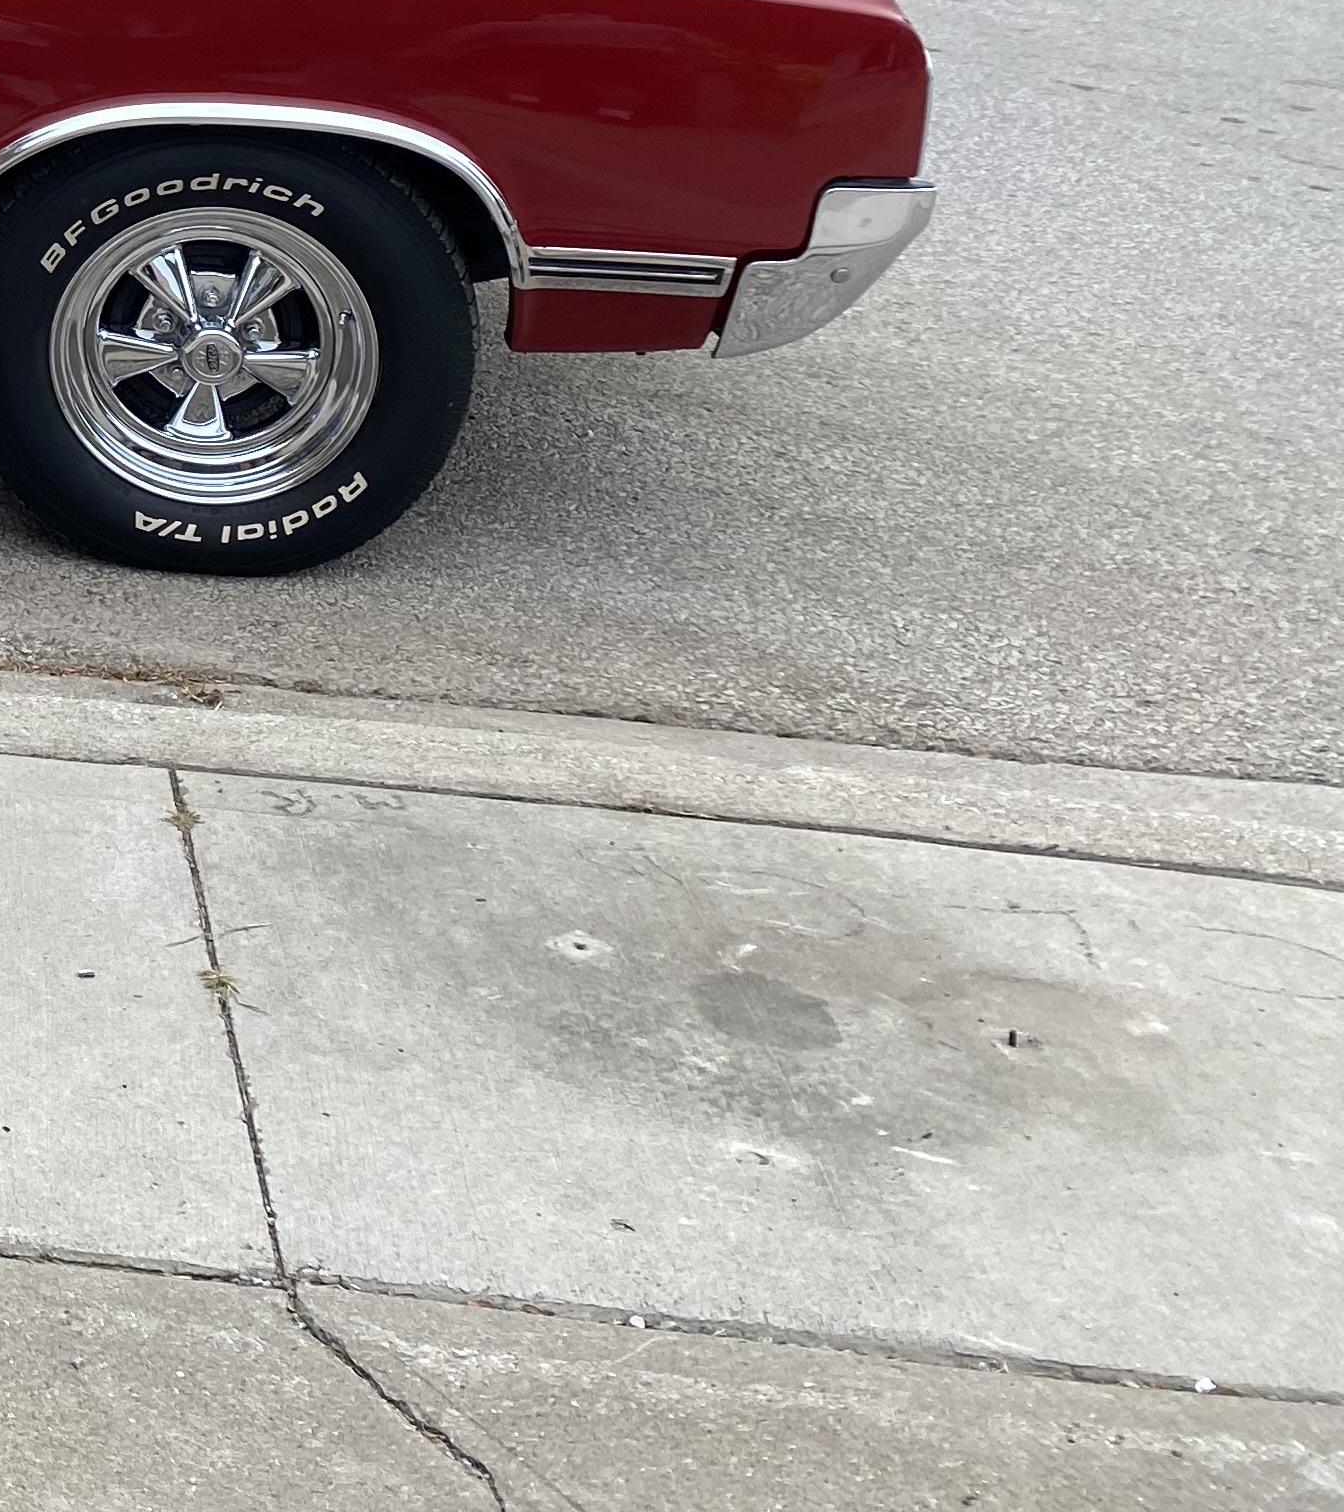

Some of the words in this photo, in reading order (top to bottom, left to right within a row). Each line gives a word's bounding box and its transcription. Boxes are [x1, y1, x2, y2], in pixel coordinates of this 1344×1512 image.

[40, 173, 325, 274] BFGoodrich
[134, 510, 203, 542] T/A
[220, 471, 368, 543] Radial
